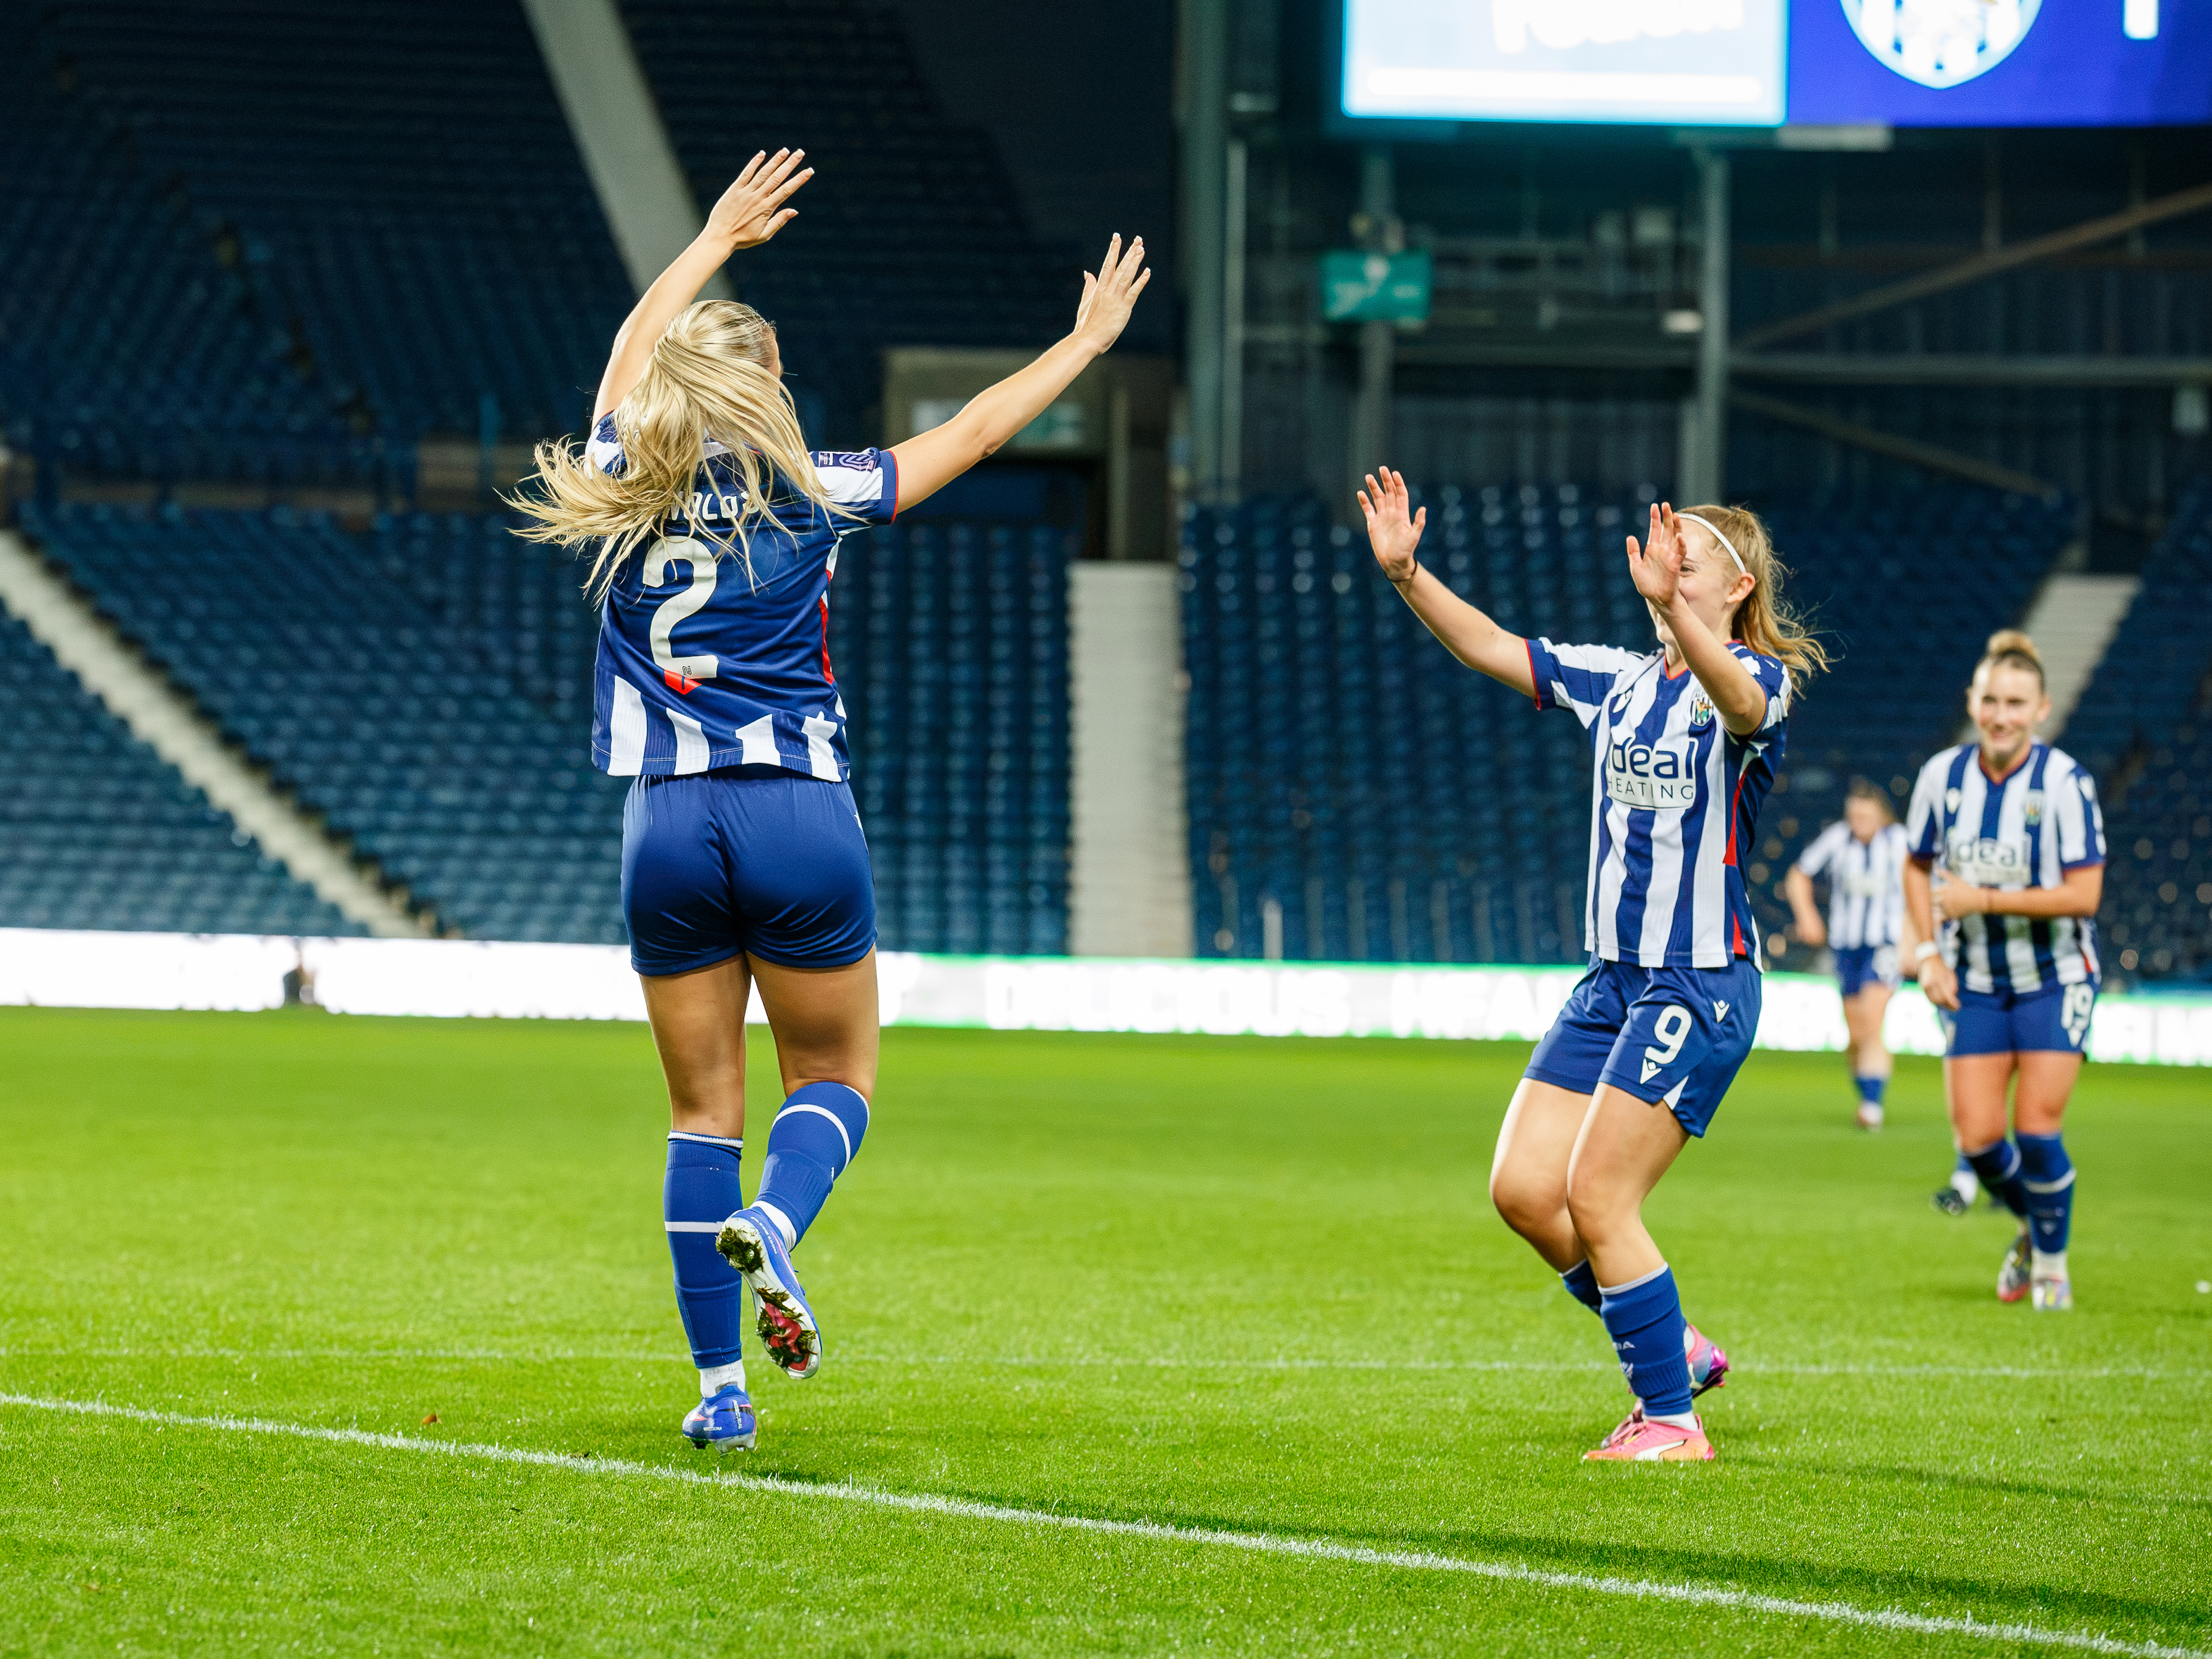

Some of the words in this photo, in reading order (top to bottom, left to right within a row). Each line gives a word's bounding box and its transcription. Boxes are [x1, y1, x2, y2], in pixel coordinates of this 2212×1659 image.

[643, 536, 719, 680] 2
[1644, 1004, 1693, 1064] 9
[2062, 983, 2094, 1029] 19
